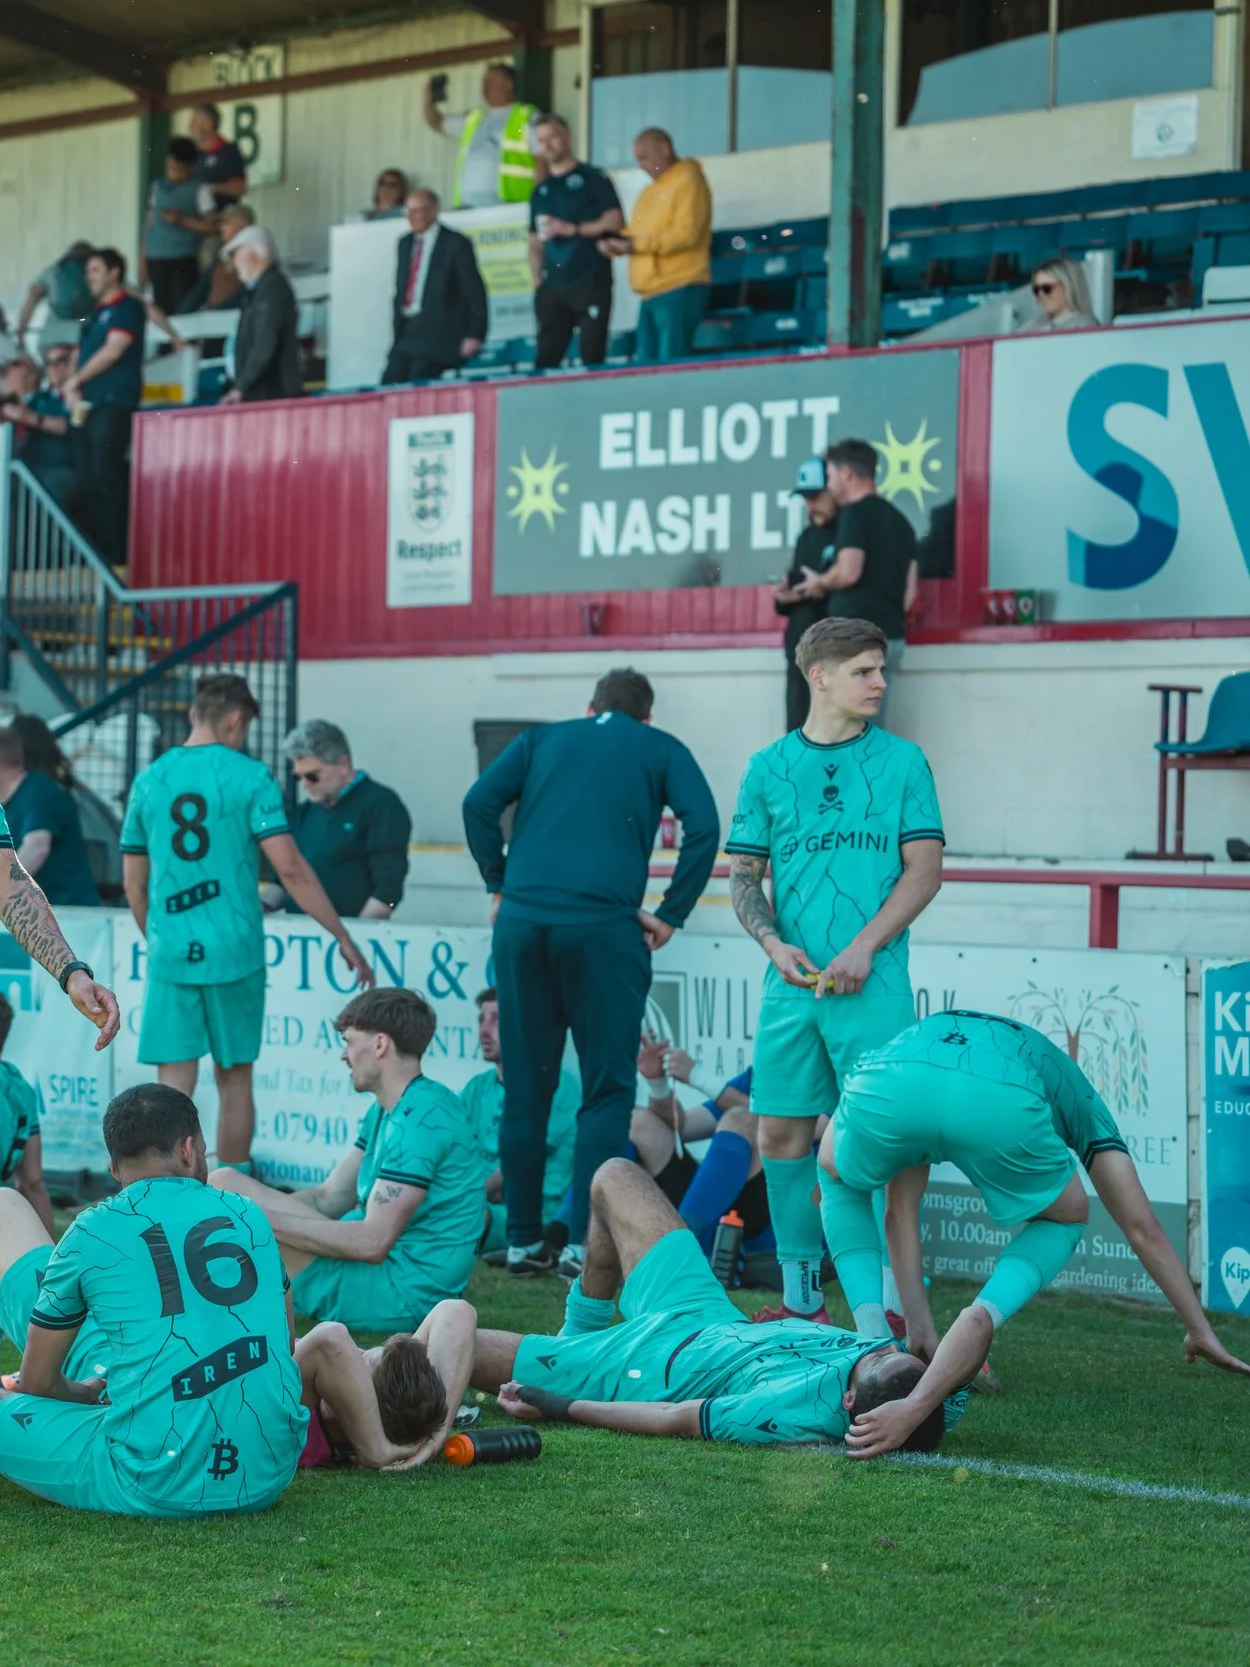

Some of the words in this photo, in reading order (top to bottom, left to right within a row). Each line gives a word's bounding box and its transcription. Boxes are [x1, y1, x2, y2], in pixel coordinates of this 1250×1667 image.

[598, 396, 840, 470] ELLIOTT
[579, 493, 730, 557] NASH
[751, 490, 806, 550] LT
[396, 538, 463, 564] Respect
[171, 792, 210, 862] 8
[805, 831, 889, 853] GEMINI
[427, 941, 468, 1001] &
[274, 1110, 349, 1146] 07940
[1126, 1135, 1172, 1166] REE
[939, 1219, 1012, 1246] 10.00am
[139, 1216, 258, 1319] 16
[934, 1255, 971, 1275] great
[1051, 1266, 1128, 1293] gardening
[180, 1340, 261, 1396] IREN
